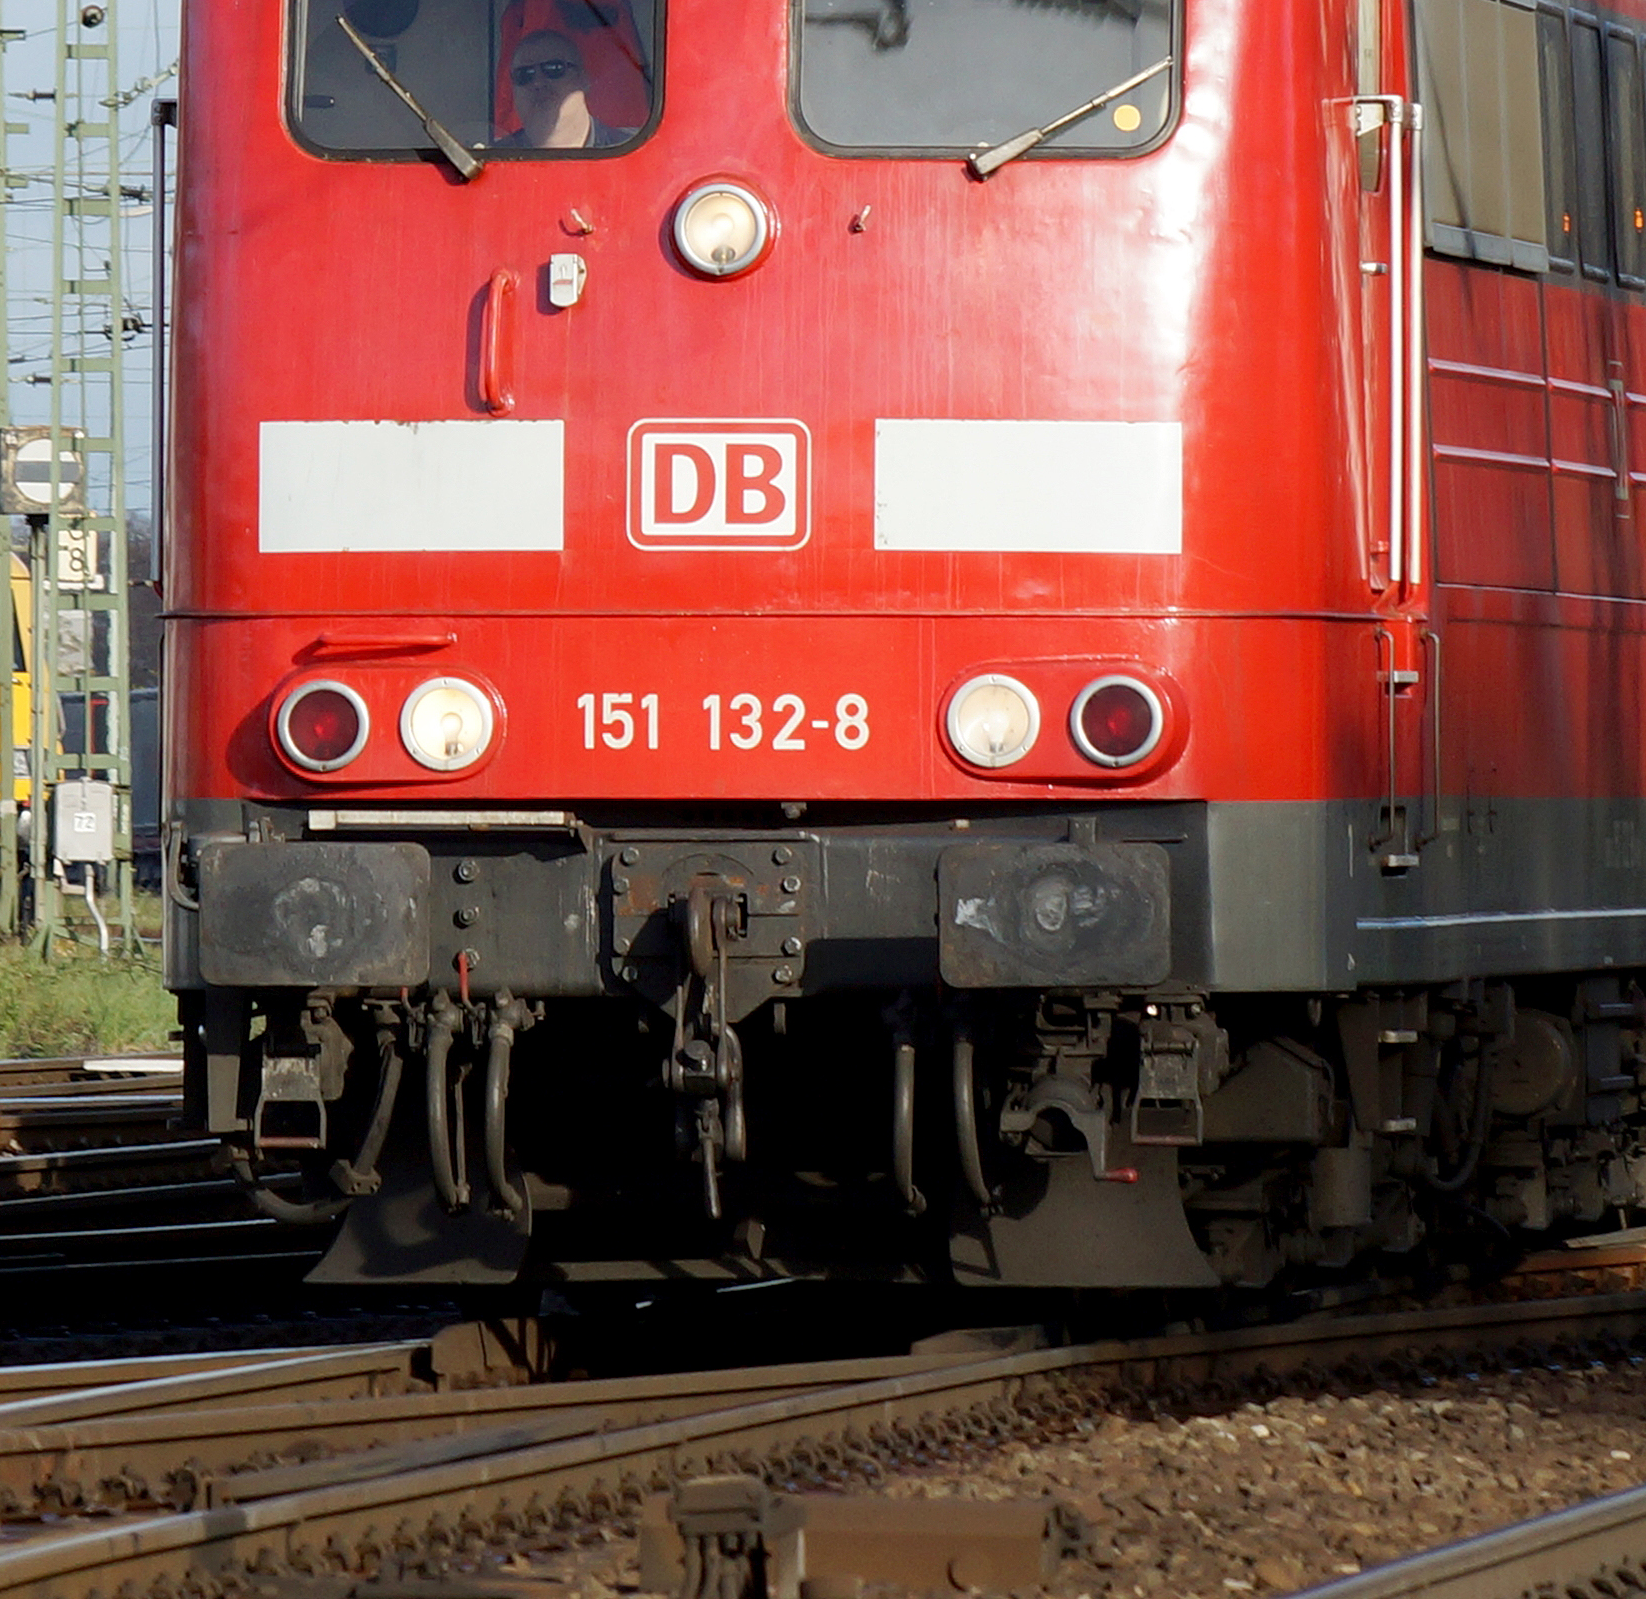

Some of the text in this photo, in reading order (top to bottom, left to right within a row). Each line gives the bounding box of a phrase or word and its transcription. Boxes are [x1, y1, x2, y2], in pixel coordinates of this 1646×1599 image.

[654, 443, 786, 524] DB
[577, 692, 870, 750] 151 132-8
